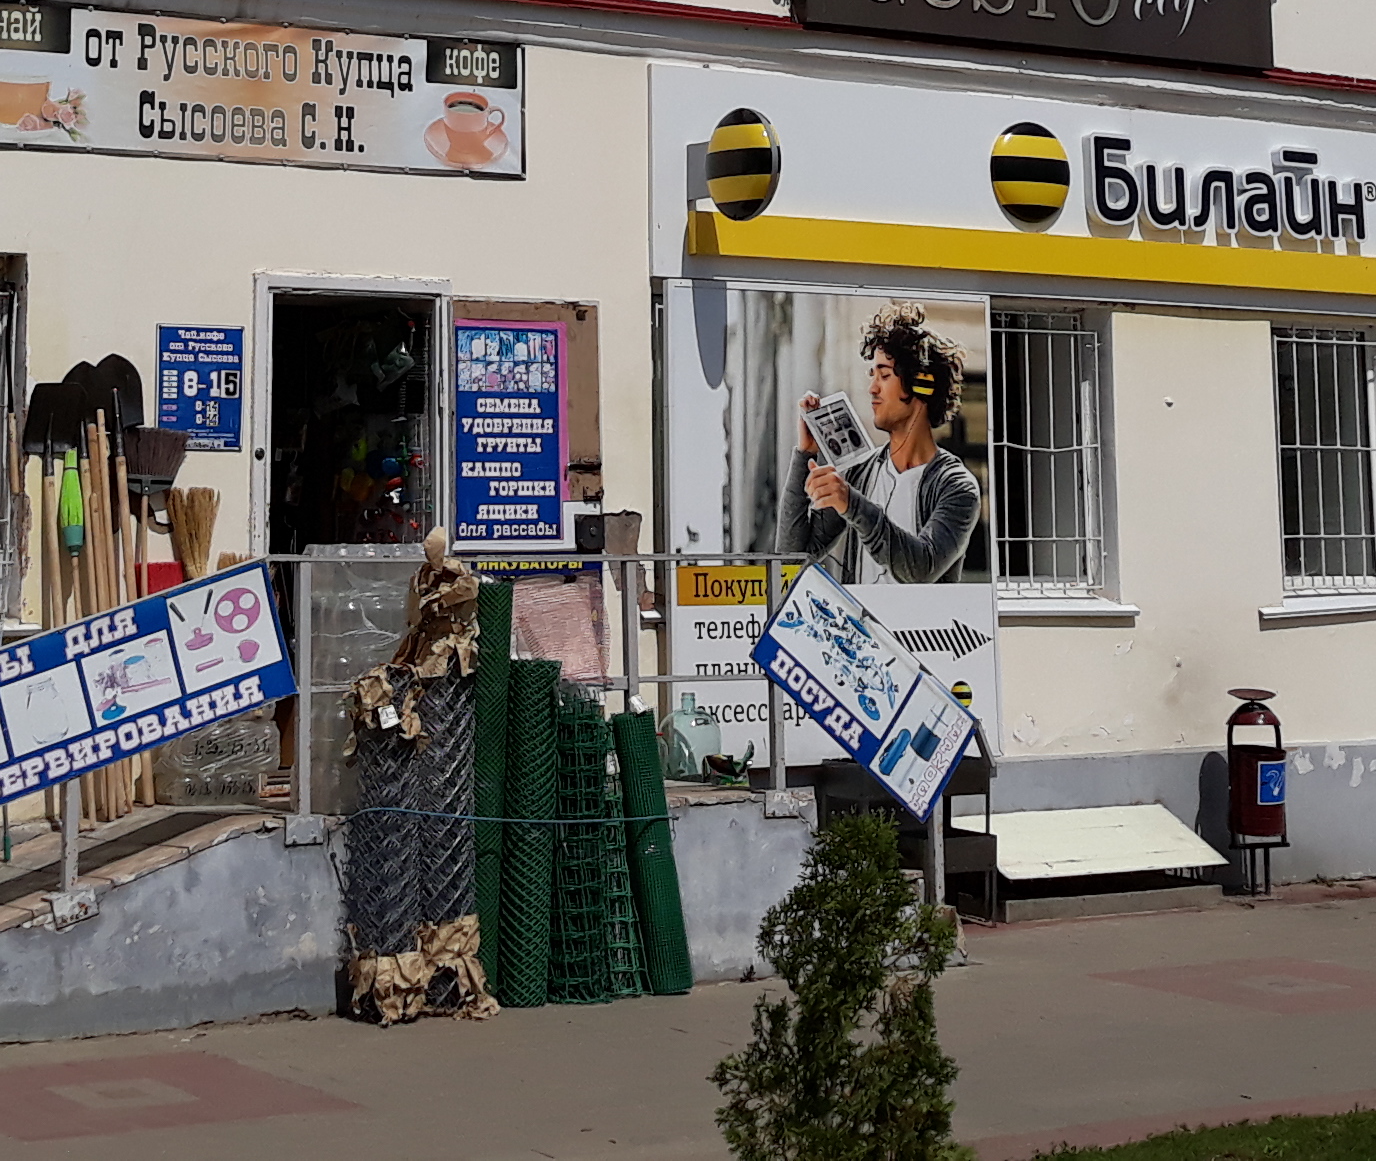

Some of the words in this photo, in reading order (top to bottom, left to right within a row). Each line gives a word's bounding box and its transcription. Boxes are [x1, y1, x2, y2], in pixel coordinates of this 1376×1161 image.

[84, 28, 123, 68] от
[137, 22, 299, 81] Русского
[311, 40, 413, 98] Купца
[444, 44, 500, 85] кофе
[138, 90, 286, 147] Сысоева
[476, 398, 541, 413] СЕМЕНА
[461, 418, 554, 434] УДОБРЕНИЯ
[476, 438, 542, 452] ГРУНТЫ
[461, 462, 521, 477] КАШПО
[489, 481, 555, 496] ГОРШКИ
[476, 504, 538, 520] ЯЩИКИ
[459, 523, 487, 536] для
[493, 522, 557, 538] рассады
[65, 609, 138, 660] ДЛЯ
[769, 648, 870, 750] ПОСУДА
[907, 710, 971, 817] ТЕРМОСЫ
